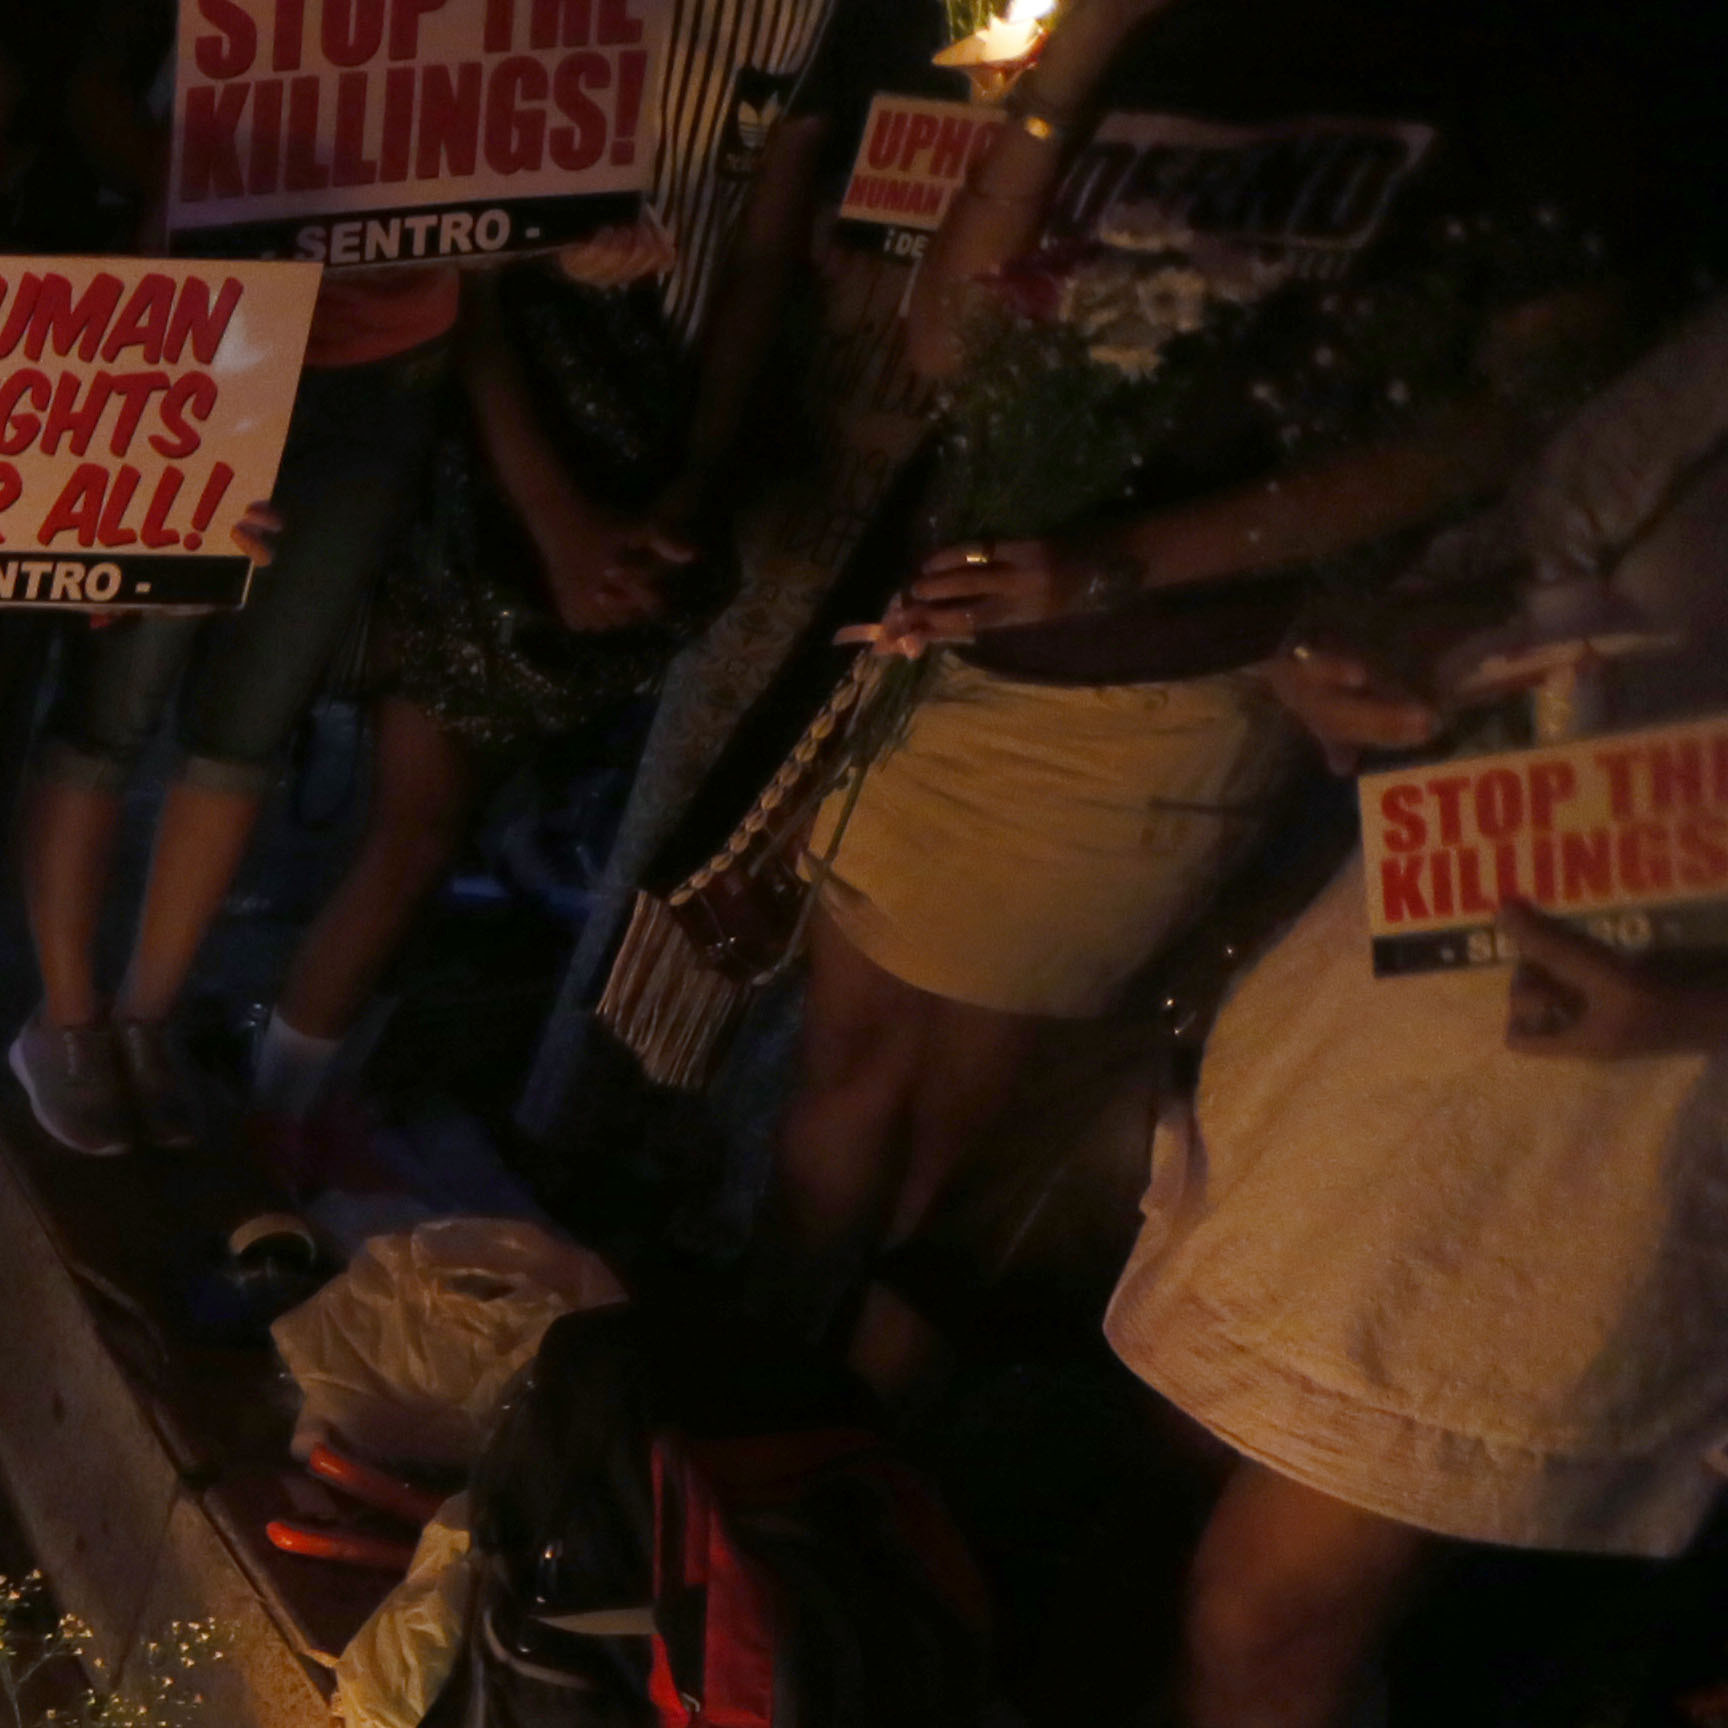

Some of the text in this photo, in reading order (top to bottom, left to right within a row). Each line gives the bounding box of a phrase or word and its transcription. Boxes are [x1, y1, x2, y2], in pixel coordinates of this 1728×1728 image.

[180, 50, 647, 202] KILLINGS!
[294, 208, 511, 265] SENTRO
[37, 460, 236, 553] ALL!
[1380, 760, 1576, 853] STOP
